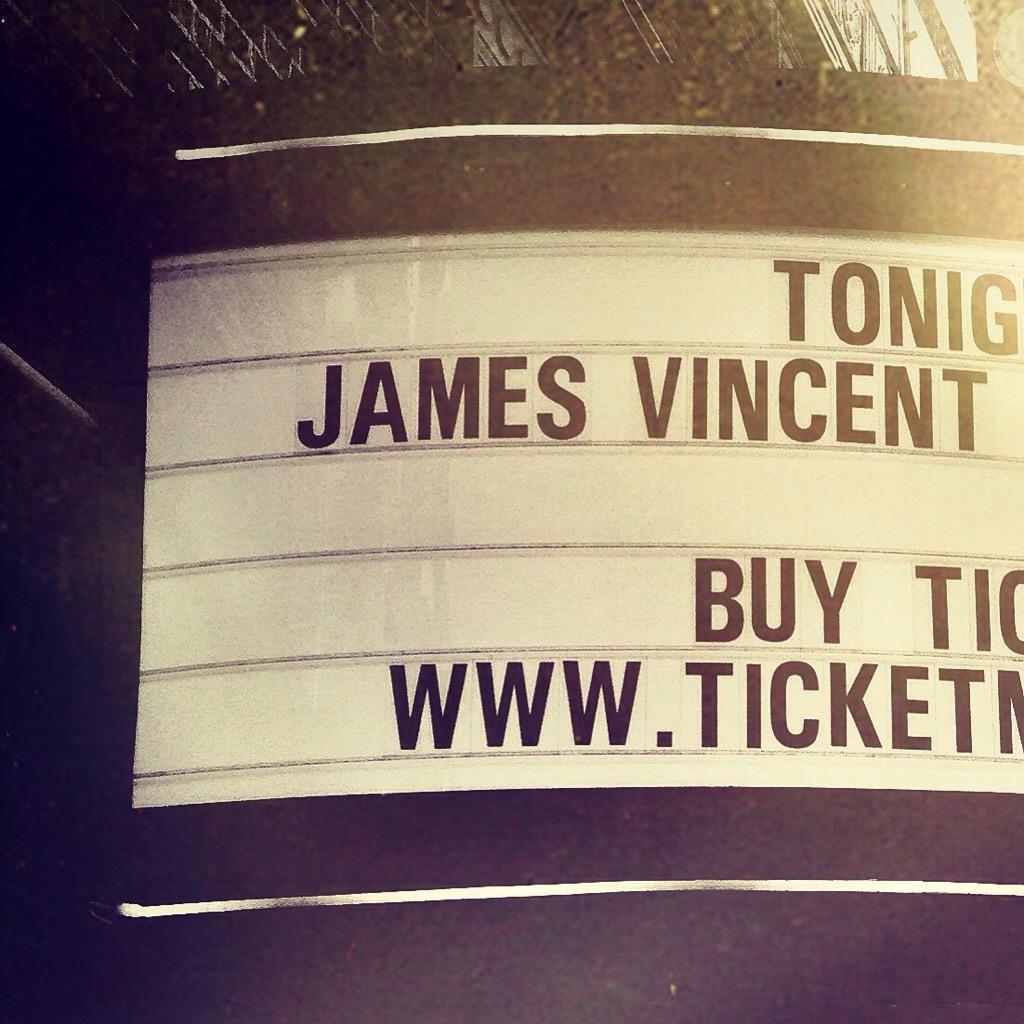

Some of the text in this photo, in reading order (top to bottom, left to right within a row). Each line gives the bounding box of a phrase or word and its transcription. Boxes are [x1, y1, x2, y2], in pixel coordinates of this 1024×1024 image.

[297, 355, 587, 450] JAMES
[632, 356, 989, 452] VINCENT
[695, 557, 859, 644] BUY
